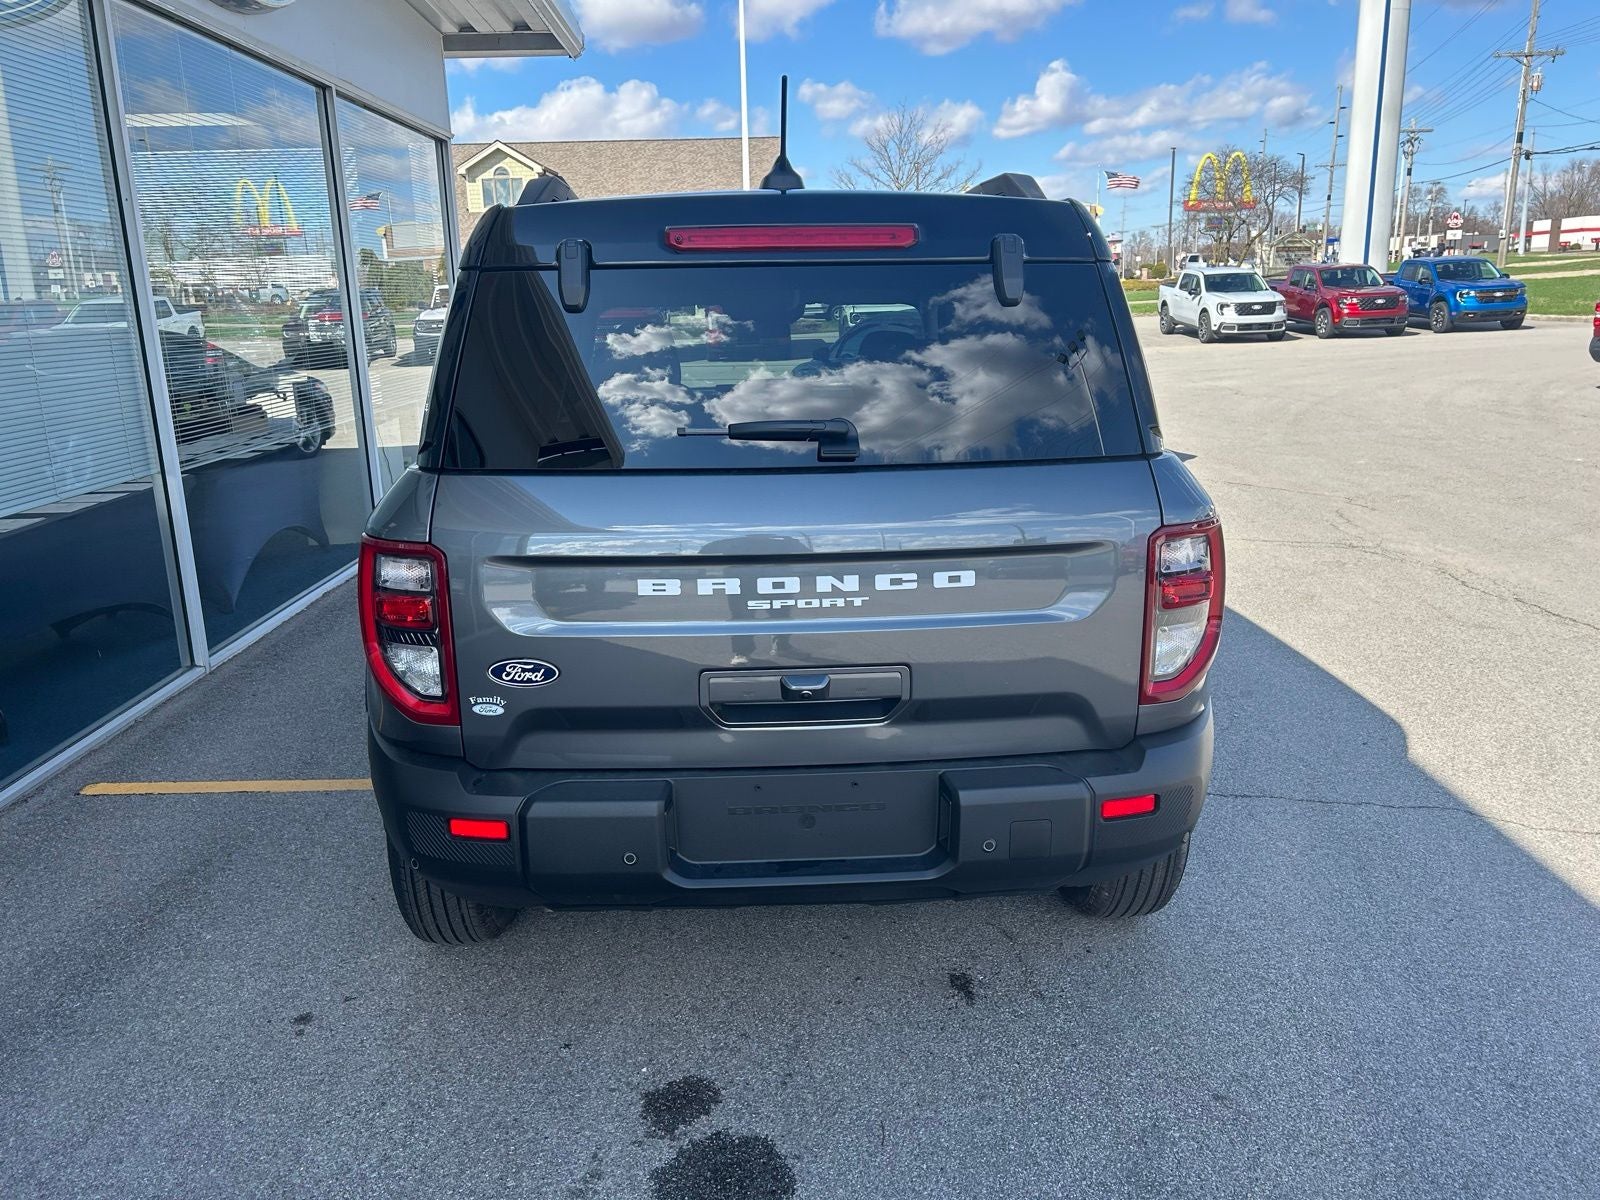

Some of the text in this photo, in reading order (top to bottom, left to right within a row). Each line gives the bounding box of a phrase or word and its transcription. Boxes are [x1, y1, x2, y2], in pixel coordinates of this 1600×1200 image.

[637, 570, 976, 596] BRONCO
[747, 597, 870, 610] SPORT
[502, 663, 545, 681] Ford
[469, 696, 507, 707] Family
[478, 705, 498, 714] Ford
[727, 802, 887, 816] BRONCO
